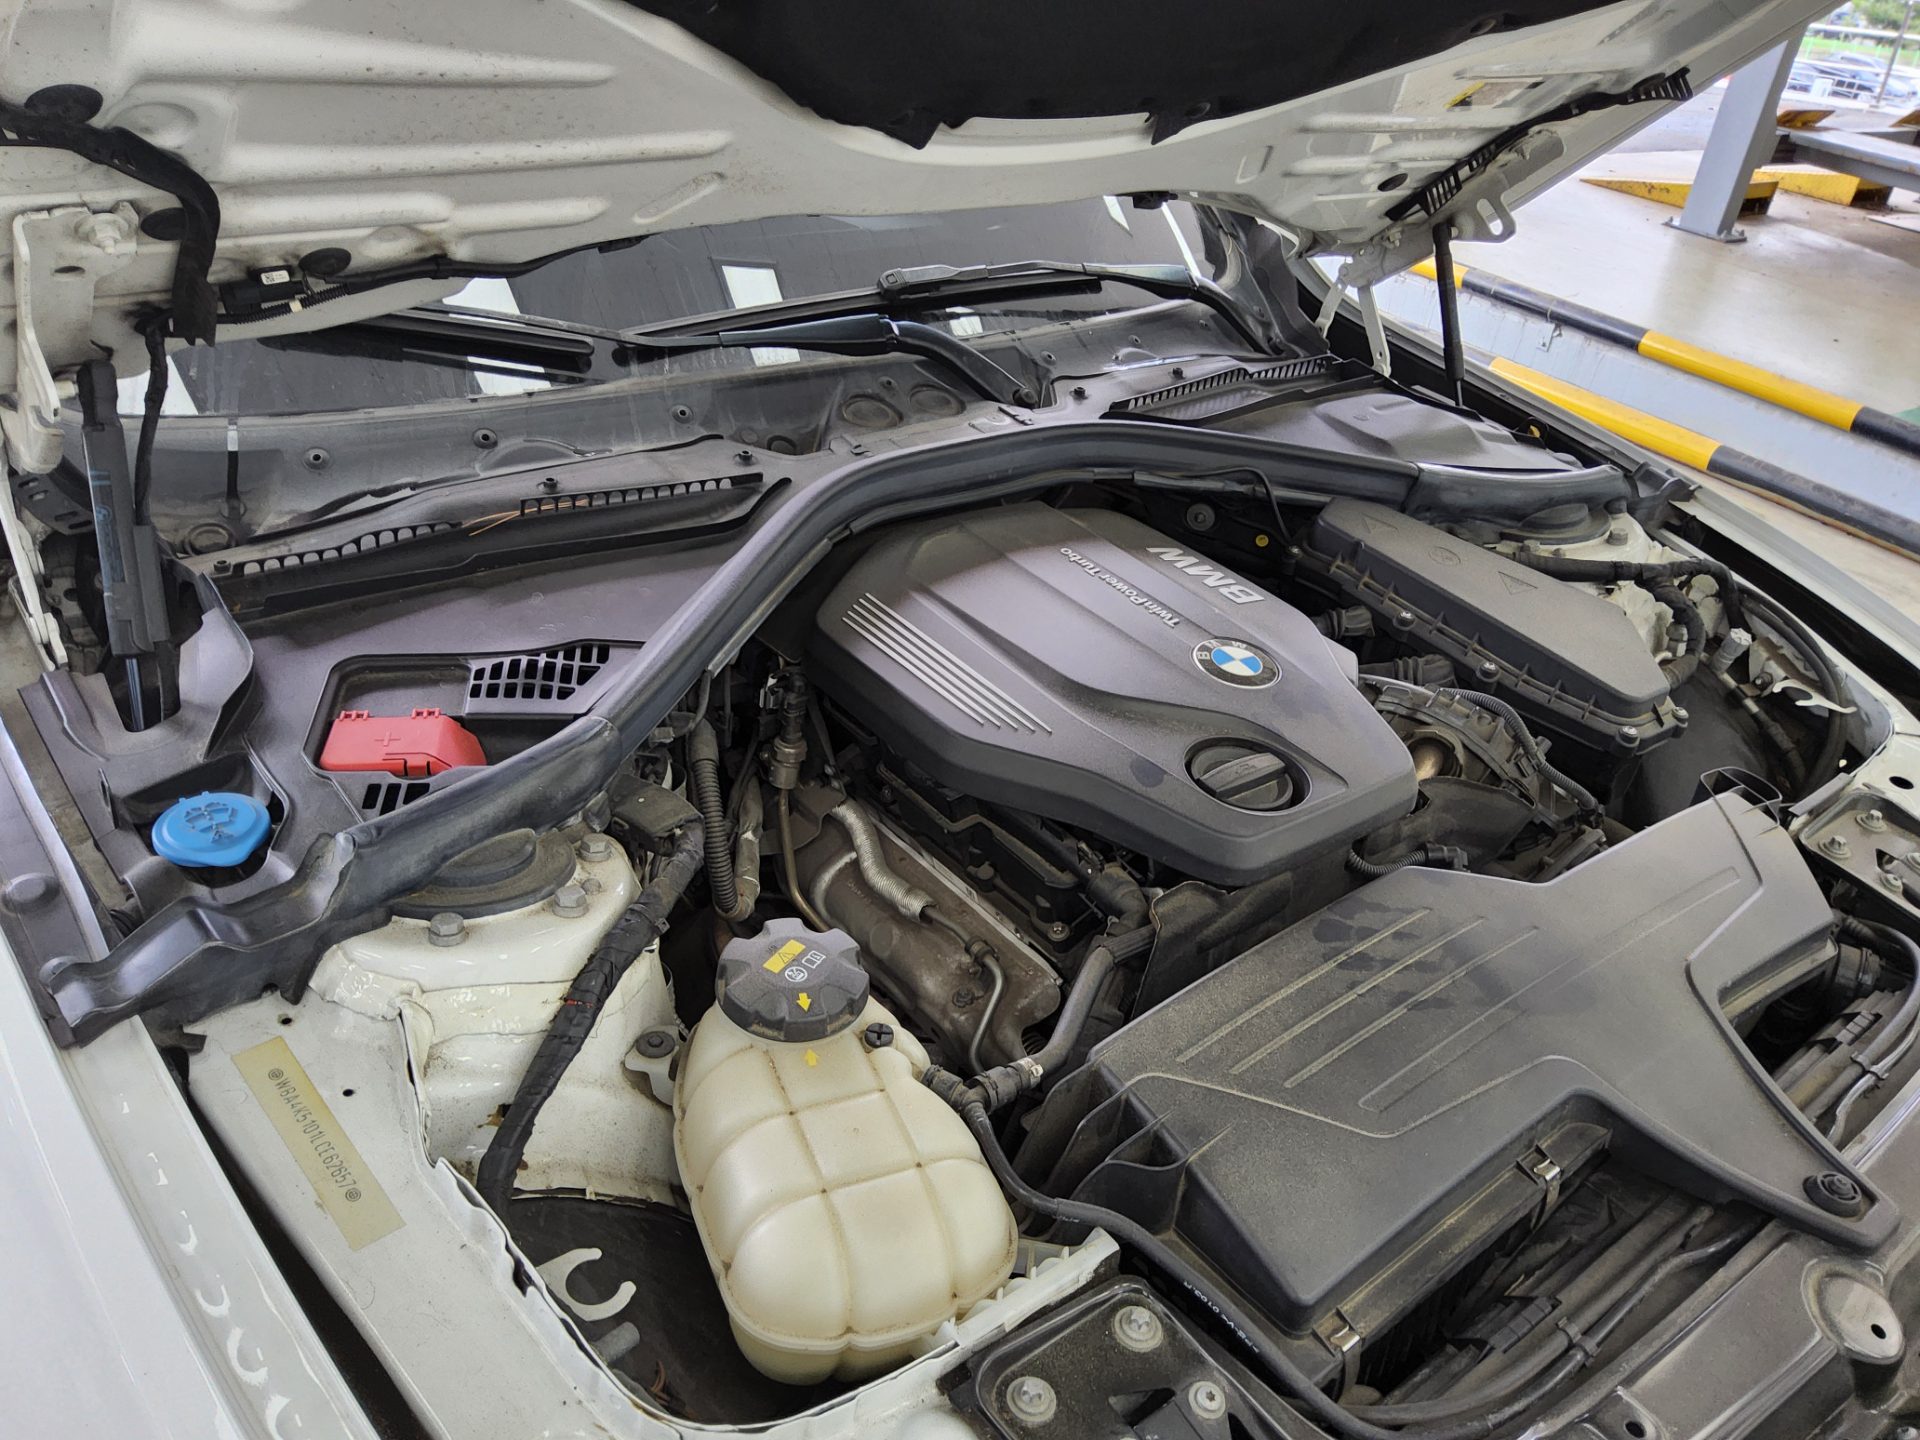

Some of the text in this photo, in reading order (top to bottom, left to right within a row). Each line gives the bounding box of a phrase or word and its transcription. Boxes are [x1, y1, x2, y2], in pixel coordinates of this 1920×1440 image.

[1060, 547, 1180, 628] TwinPower Turbo
[1146, 547, 1264, 604] BMW
[1198, 641, 1247, 661] BMW
